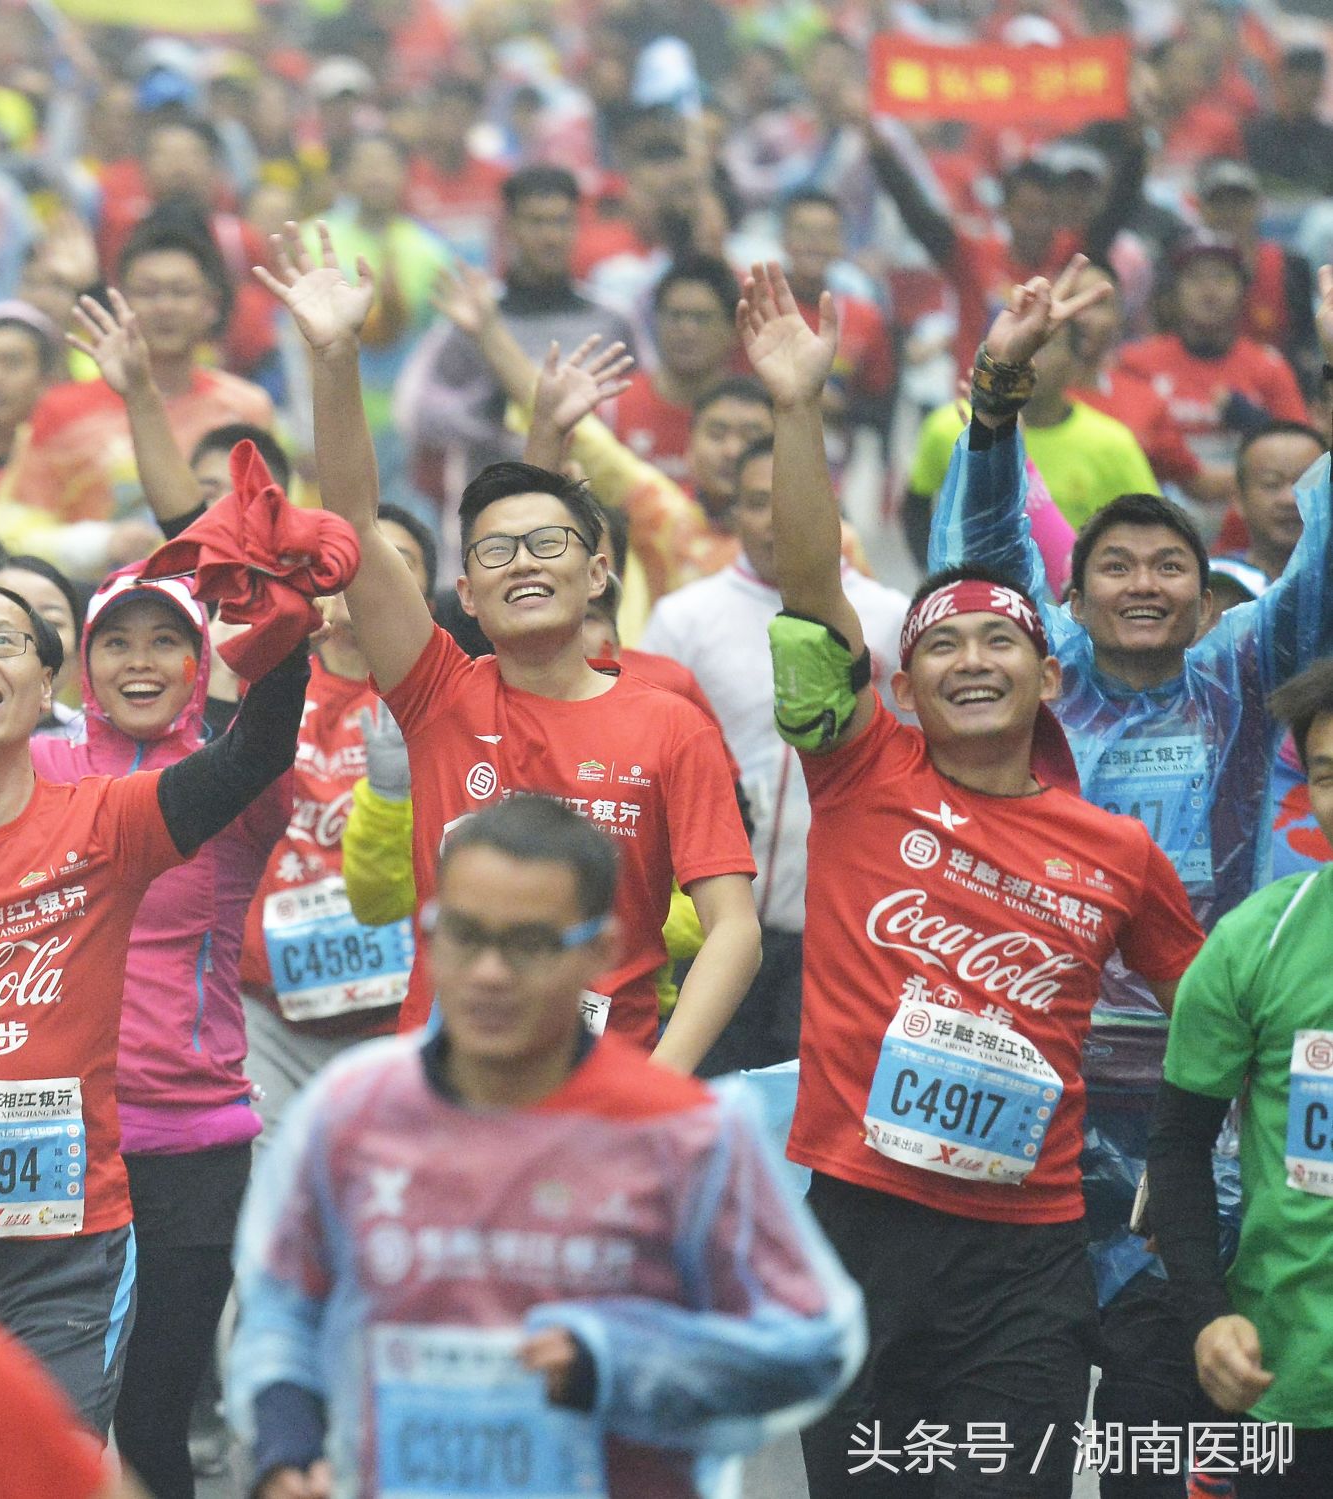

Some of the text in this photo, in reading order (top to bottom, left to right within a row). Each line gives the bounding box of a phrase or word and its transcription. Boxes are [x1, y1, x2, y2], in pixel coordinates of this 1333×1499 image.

[609, 824, 637, 837] BANK
[943, 870, 1098, 943] HUARONG XIANGJIANG BANK
[948, 848, 1103, 931] 华融湘江银行
[282, 931, 384, 984] C4585
[866, 888, 1083, 1010] Coca-Cola
[930, 1037, 1055, 1079] HUARONG XIANGJIANG BANK
[1, 1108, 49, 1119] XIANGJIANG
[51, 1108, 72, 1116] BANK
[891, 1068, 1007, 1140] C4917
